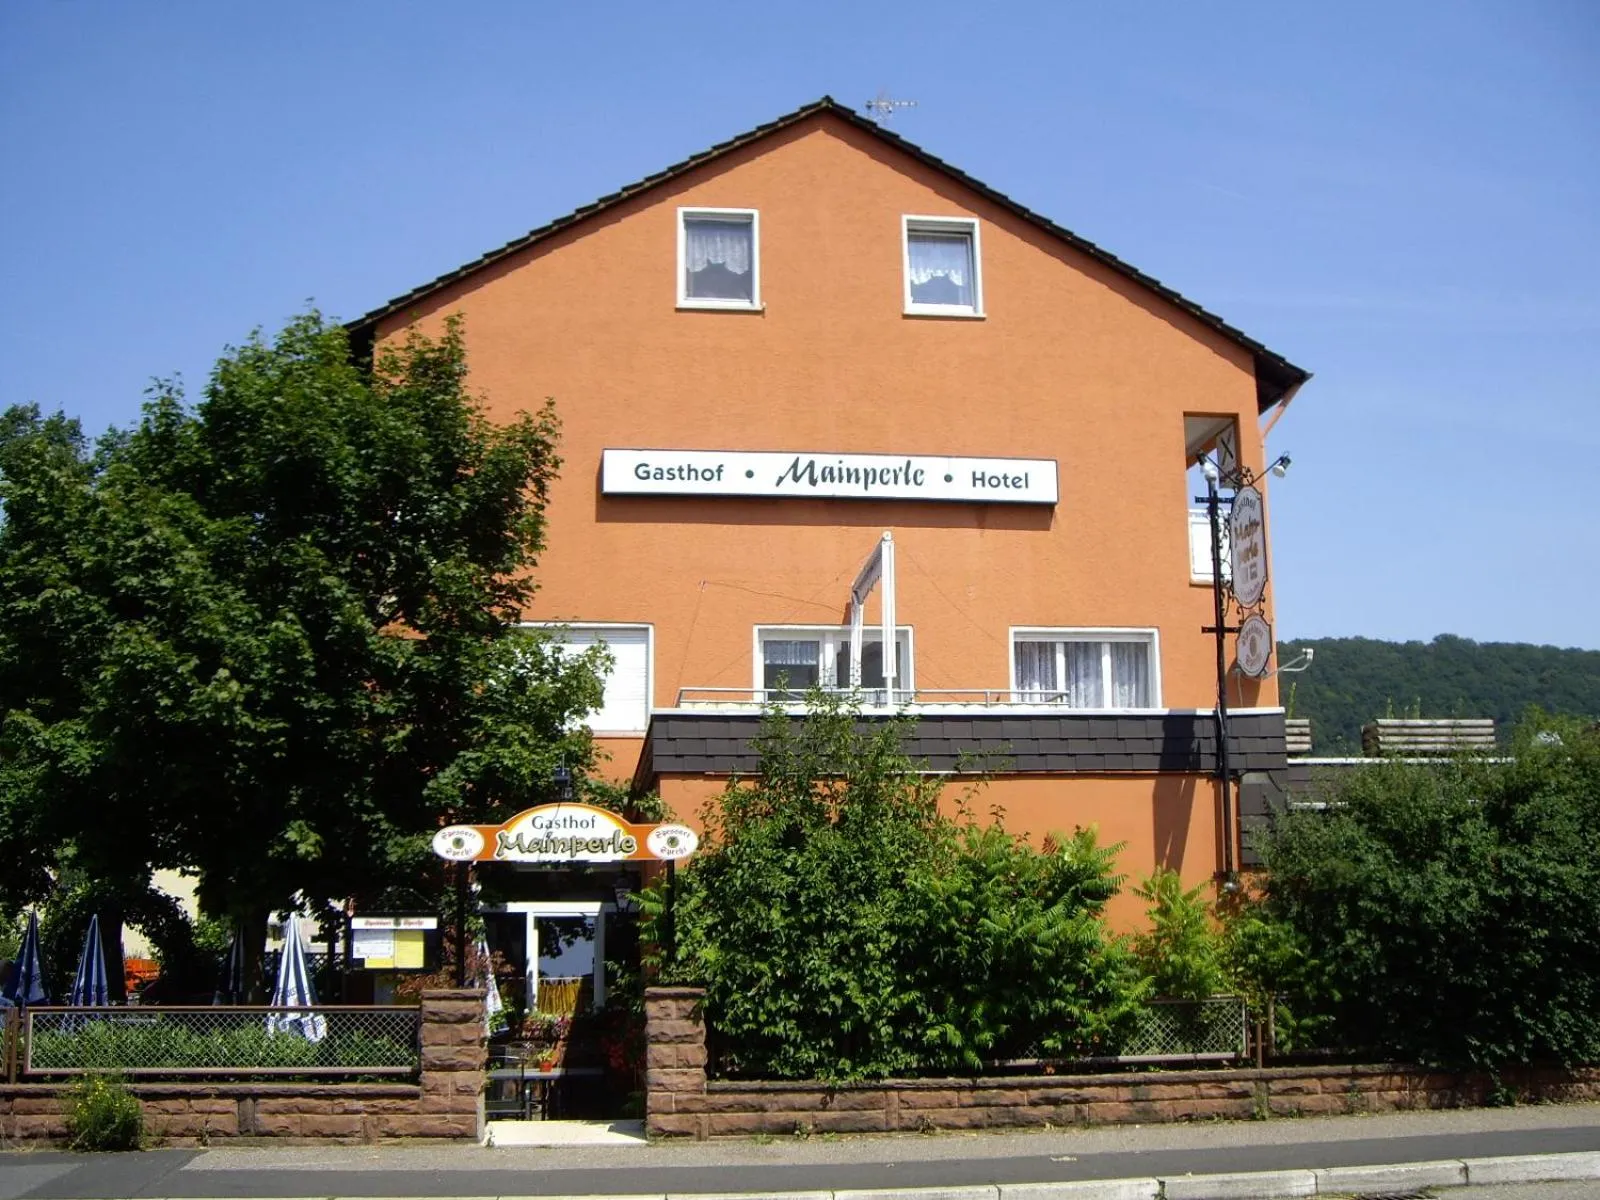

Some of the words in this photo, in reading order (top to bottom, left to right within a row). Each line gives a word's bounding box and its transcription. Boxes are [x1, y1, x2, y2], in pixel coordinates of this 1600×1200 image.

[634, 463, 724, 481] Gasthof
[775, 456, 925, 491] Mainperle
[972, 471, 1029, 489] Hotel
[531, 815, 596, 830] Gasthof
[497, 829, 636, 859] Mainperle
